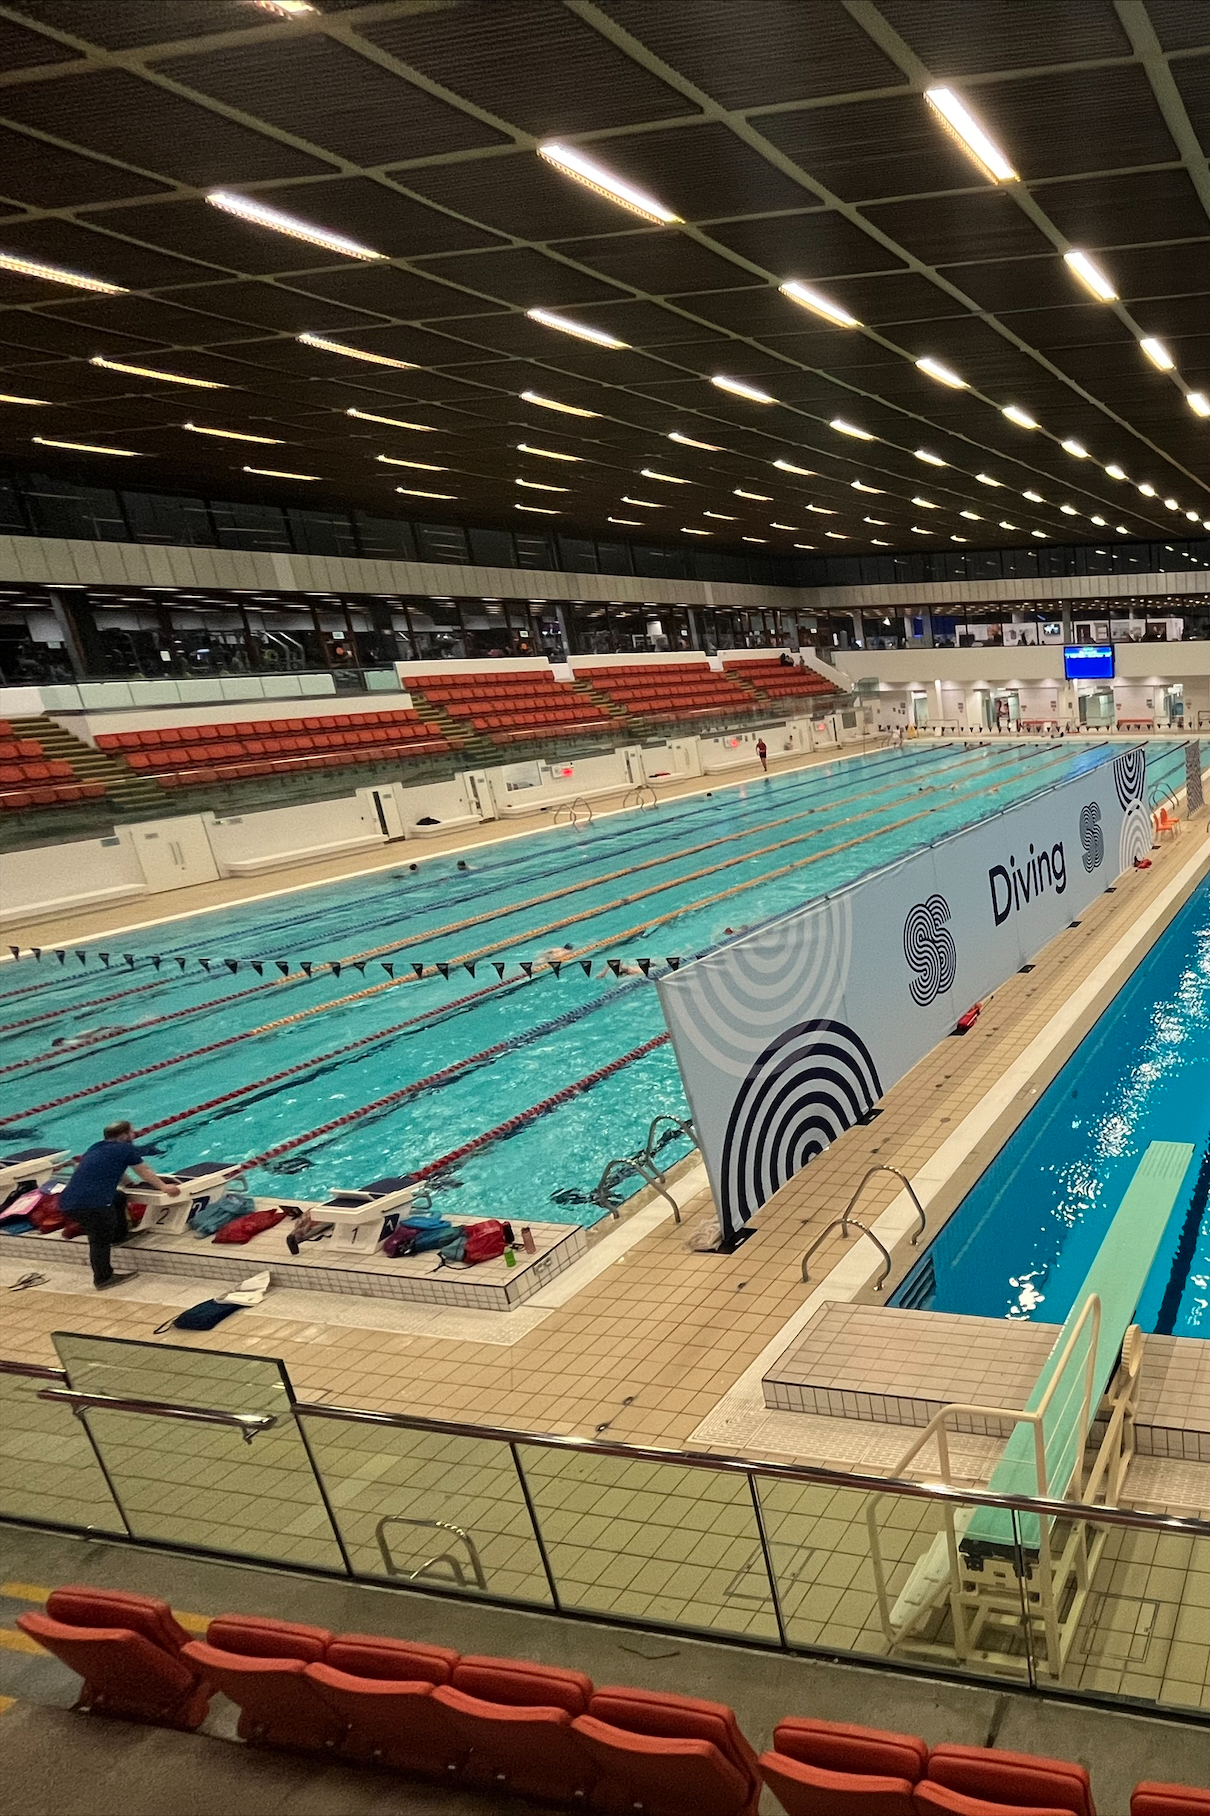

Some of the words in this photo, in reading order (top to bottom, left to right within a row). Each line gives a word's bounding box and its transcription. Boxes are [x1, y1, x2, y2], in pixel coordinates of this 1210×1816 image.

[988, 841, 1067, 927] Diving
[155, 1207, 170, 1225] 2
[351, 1226, 359, 1244] 1
[386, 1219, 395, 1231] 1
